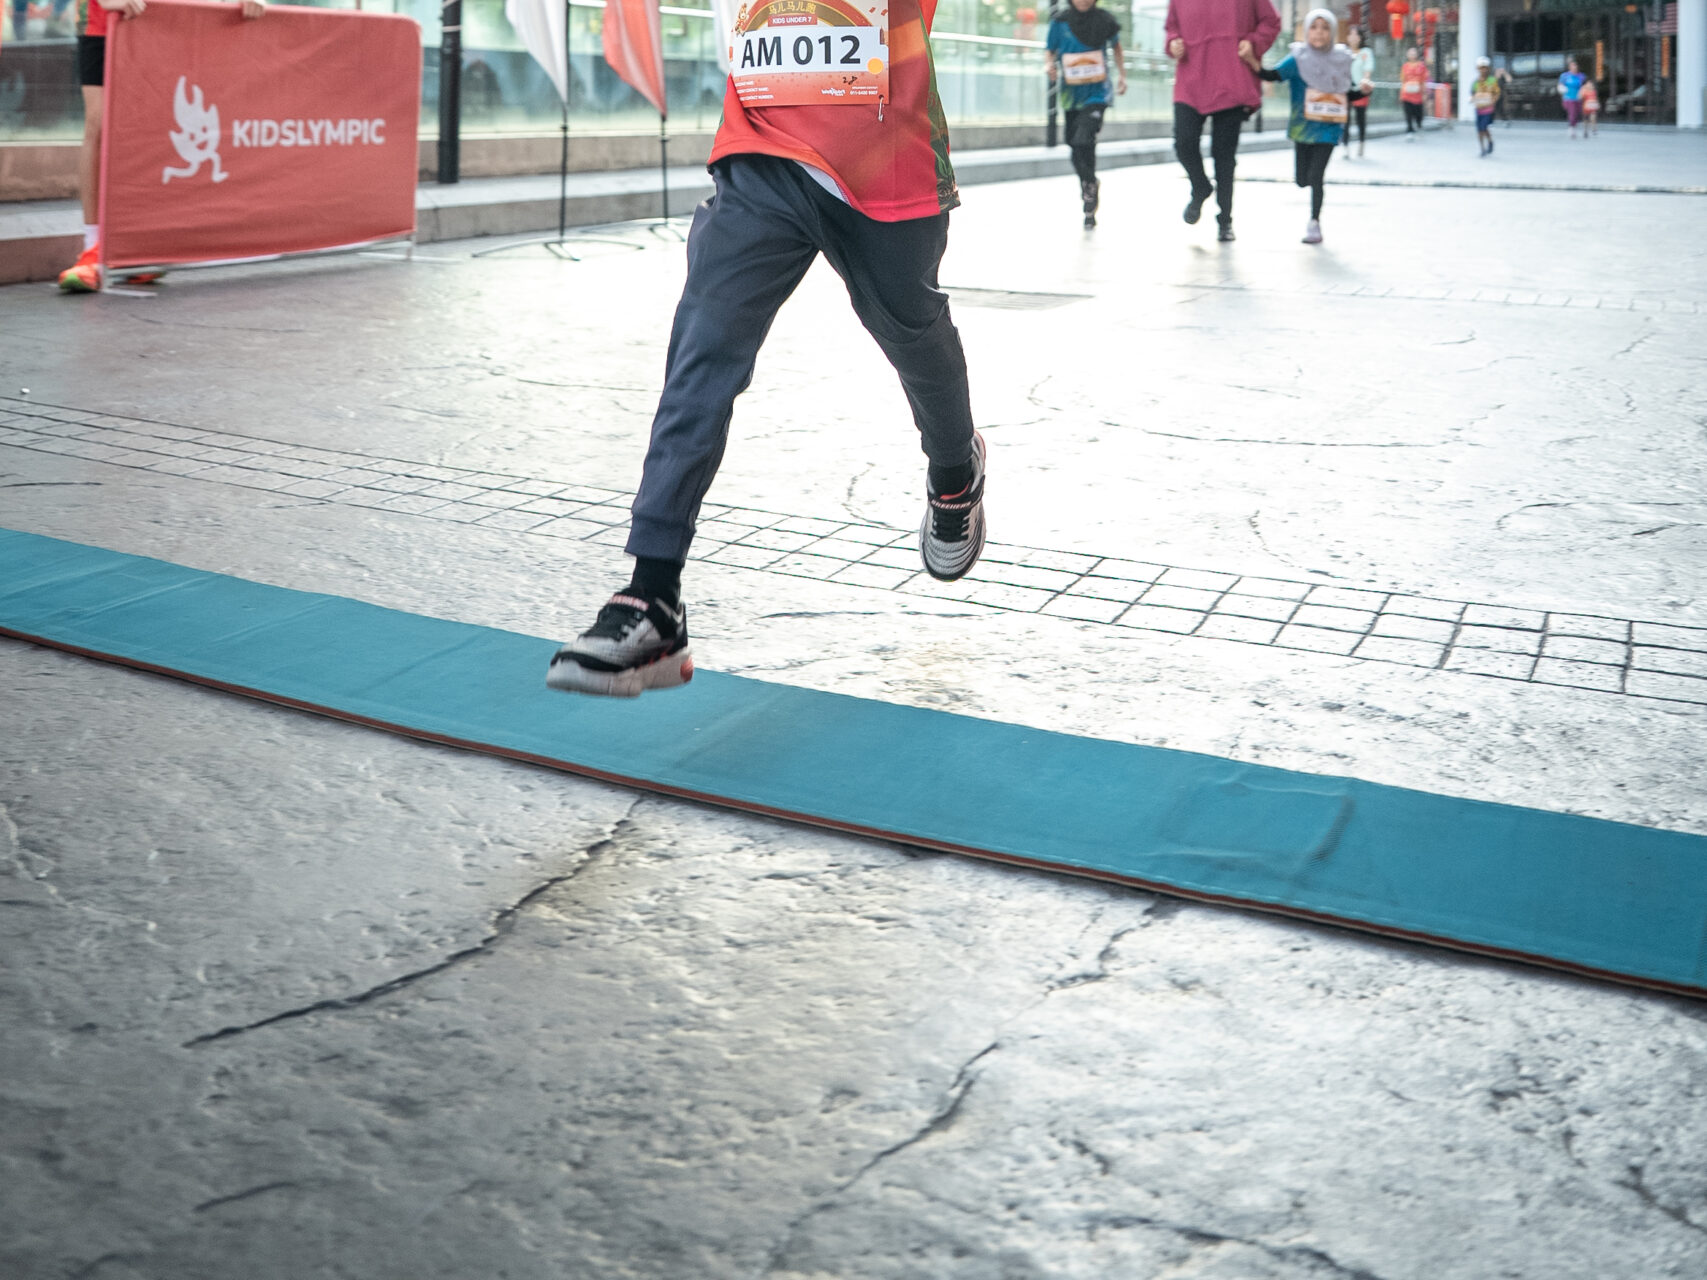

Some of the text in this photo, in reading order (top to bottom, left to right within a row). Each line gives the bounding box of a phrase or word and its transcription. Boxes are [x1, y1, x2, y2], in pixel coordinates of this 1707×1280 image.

[741, 35, 861, 69] AM 012
[232, 118, 386, 148] KIDSLYMPIC
